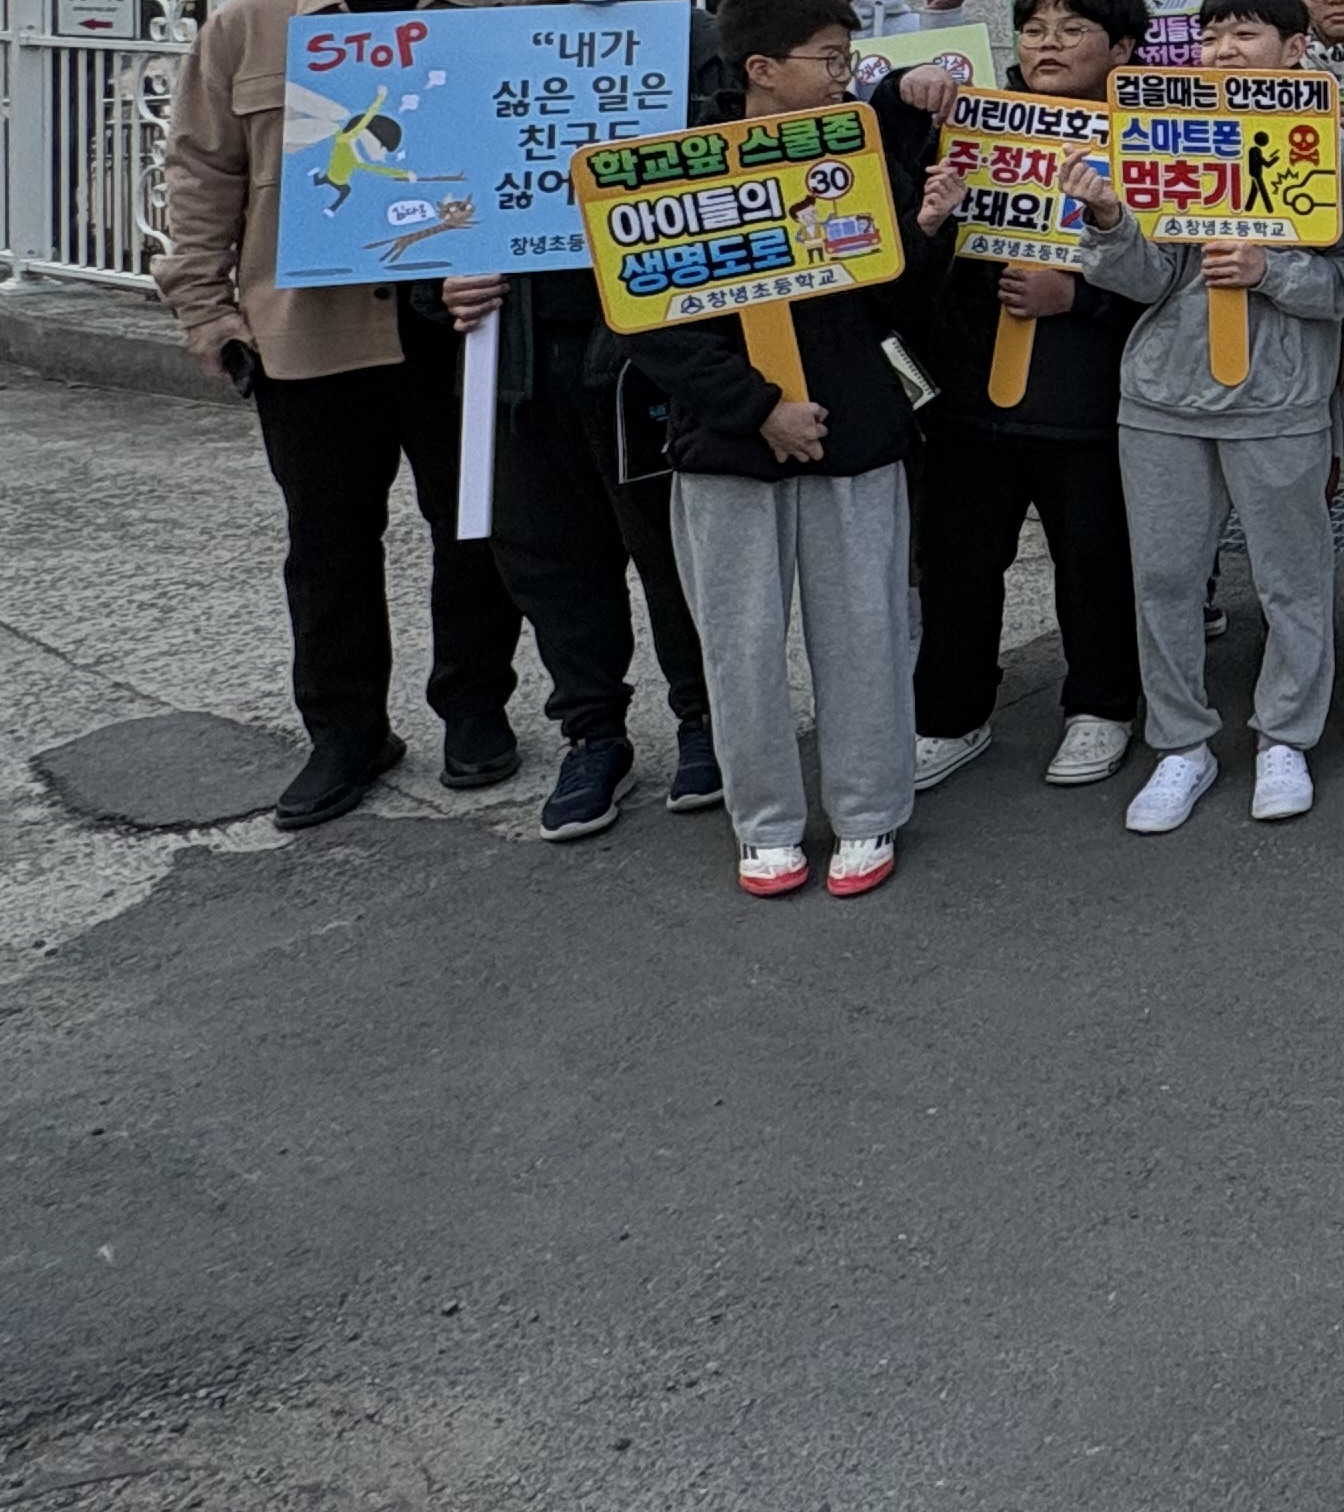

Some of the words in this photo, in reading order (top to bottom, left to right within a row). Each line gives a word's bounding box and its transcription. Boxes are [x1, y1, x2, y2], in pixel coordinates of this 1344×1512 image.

[306, 20, 429, 72] STOP
[492, 76, 576, 118] 싫은
[591, 71, 674, 113] 일은
[1115, 74, 1218, 109] 걸을때는
[1224, 77, 1330, 112] 안전하게
[589, 134, 728, 188] 학교앞
[739, 110, 865, 167] 스쿨존
[1120, 117, 1243, 156] 스마트폰
[808, 165, 850, 194] 30
[1120, 159, 1244, 211] 멈추기
[609, 176, 786, 247] 아이들의
[1186, 219, 1287, 238] 창녕초등학교
[619, 227, 796, 296] 생명도로
[706, 270, 839, 309] 창녕초등학교
